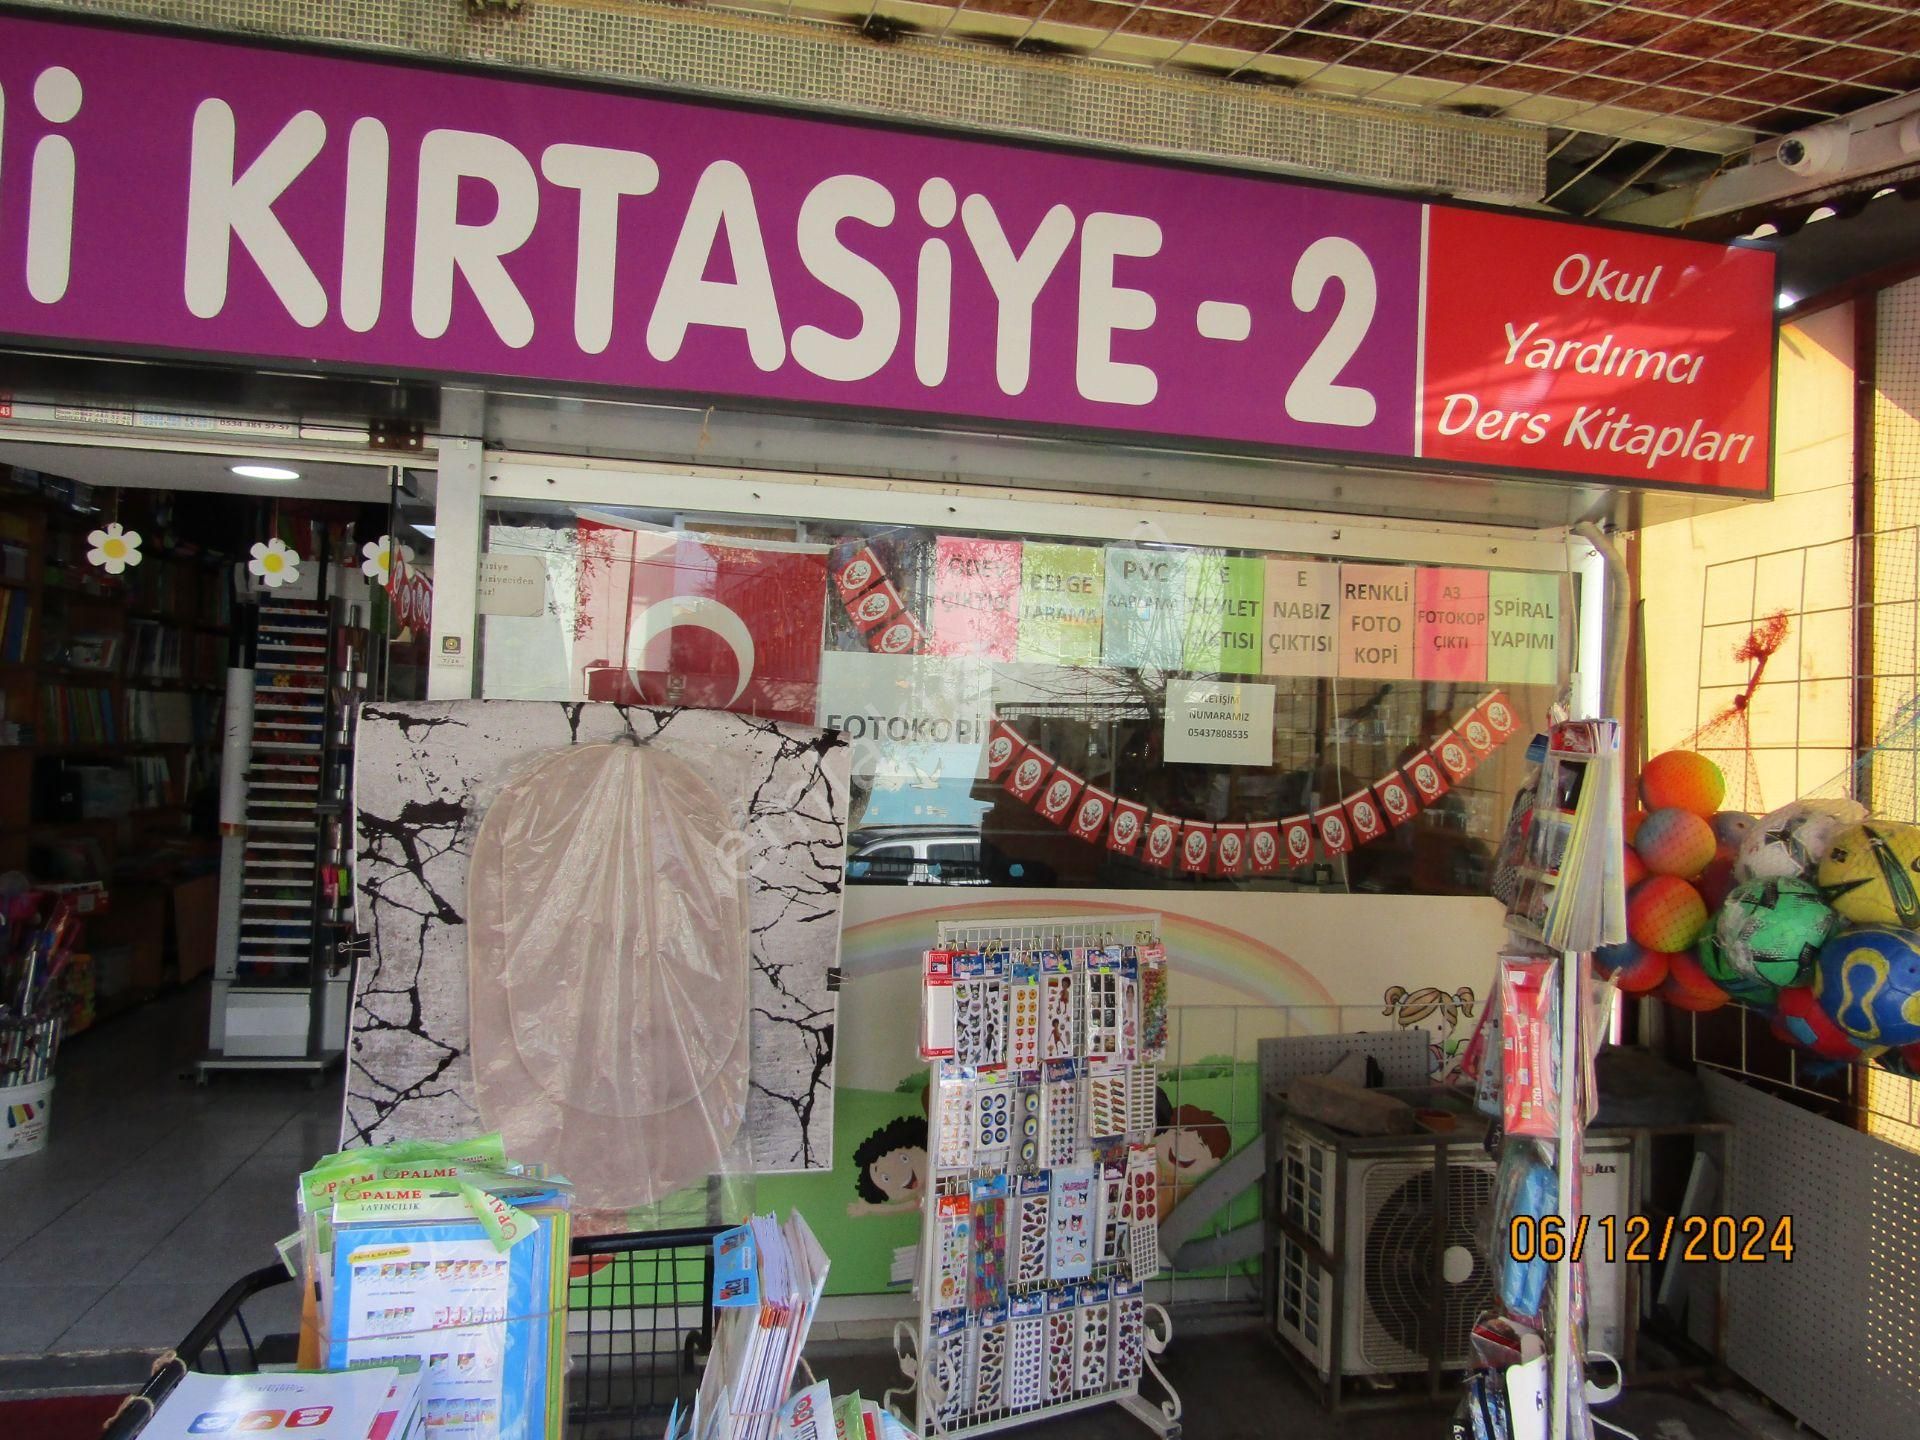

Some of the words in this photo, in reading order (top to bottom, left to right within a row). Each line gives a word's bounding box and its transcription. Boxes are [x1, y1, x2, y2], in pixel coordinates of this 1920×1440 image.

[1552, 253, 1662, 304] Okul
[1284, 236, 1378, 427] 2
[1504, 322, 1704, 384] Yardımcı
[1437, 393, 1551, 444] Ders
[1562, 406, 1755, 470] Kitapları
[1123, 560, 1169, 583] PVC
[1297, 570, 1307, 587] E
[1345, 581, 1409, 602] RENKLİ
[1442, 586, 1461, 600] A3
[1273, 601, 1331, 620] NABIZ
[1493, 597, 1554, 620] SPİRAL
[1351, 615, 1402, 634] FOTO
[1268, 633, 1333, 654] ÇIKTISI
[1433, 636, 1469, 651] ÇIKTI
[1491, 630, 1555, 650] YAPIMI
[1354, 644, 1398, 665] KOPİ
[1188, 710, 1250, 722] NUMARAMIZ
[827, 713, 981, 744] FOTOKOPİ
[1187, 728, 1249, 739] 05437808535
[401, 1167, 458, 1179] PALME
[361, 1189, 423, 1200] PALME
[360, 1202, 421, 1211] YAYINCILIK
